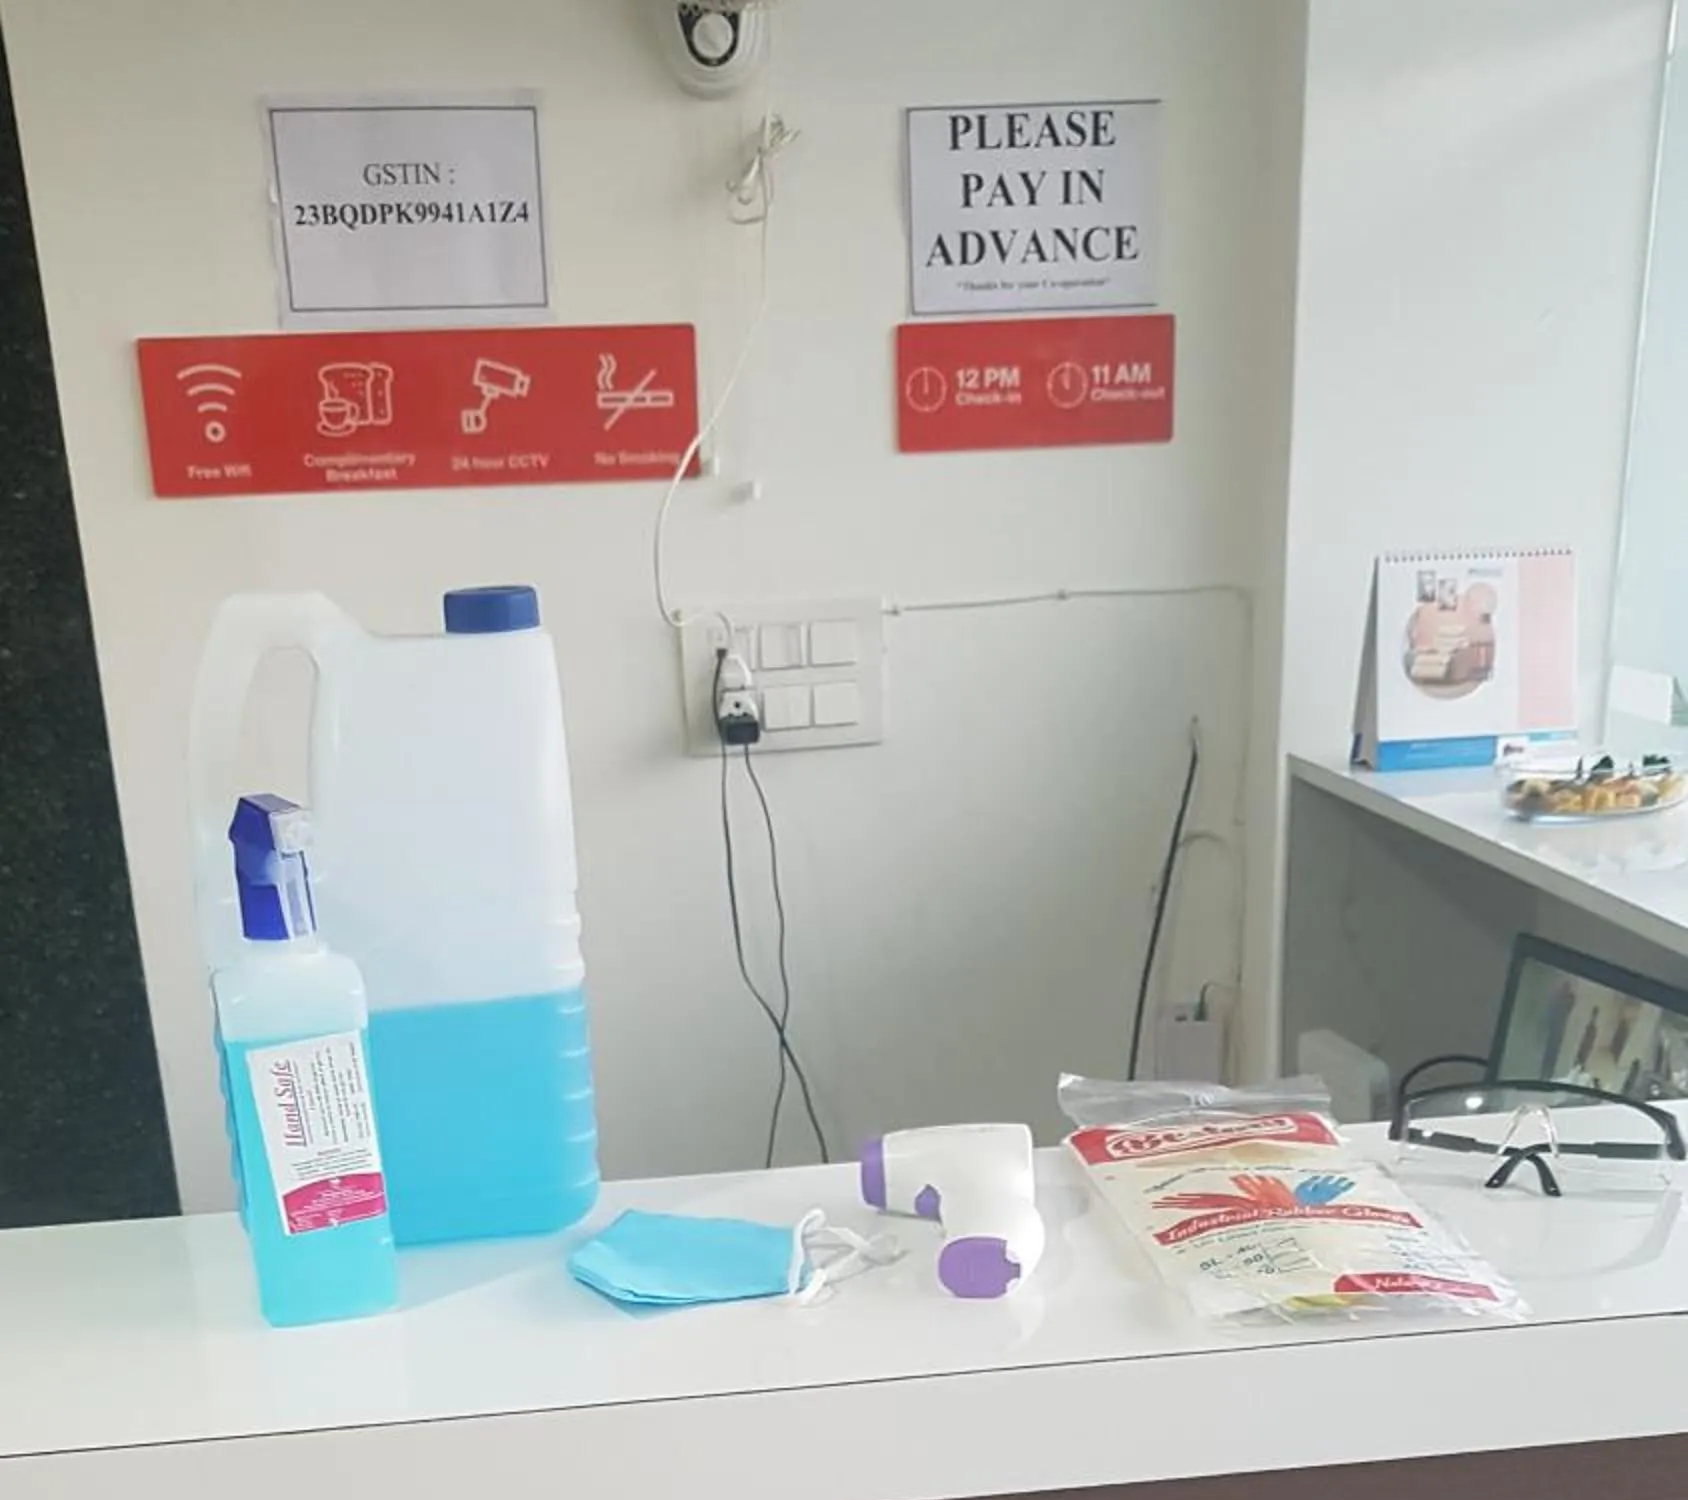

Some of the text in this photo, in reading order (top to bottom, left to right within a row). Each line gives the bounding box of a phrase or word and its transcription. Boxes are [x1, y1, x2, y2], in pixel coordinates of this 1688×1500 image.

[948, 109, 1116, 150] PLEASE
[363, 163, 440, 187] GSTIN
[961, 170, 1105, 208] PAY IN
[295, 200, 529, 230] 23BQDPK9941A1Z4
[926, 226, 1138, 267] ADVANCE
[956, 367, 1021, 389] 12 PM
[1091, 363, 1152, 384] 11 AM
[955, 390, 1022, 406] Check-in
[1090, 387, 1166, 402] Check-out
[304, 452, 416, 468] Complimentary
[472, 456, 504, 469] hour
[508, 454, 550, 469] CCTV
[595, 451, 682, 467] No Smoking
[187, 465, 222, 480] Free
[326, 467, 398, 482] Breakfast
[272, 1059, 307, 1148] Hand Safe
[1166, 1205, 1411, 1242] Industrial Rubber Gloves
